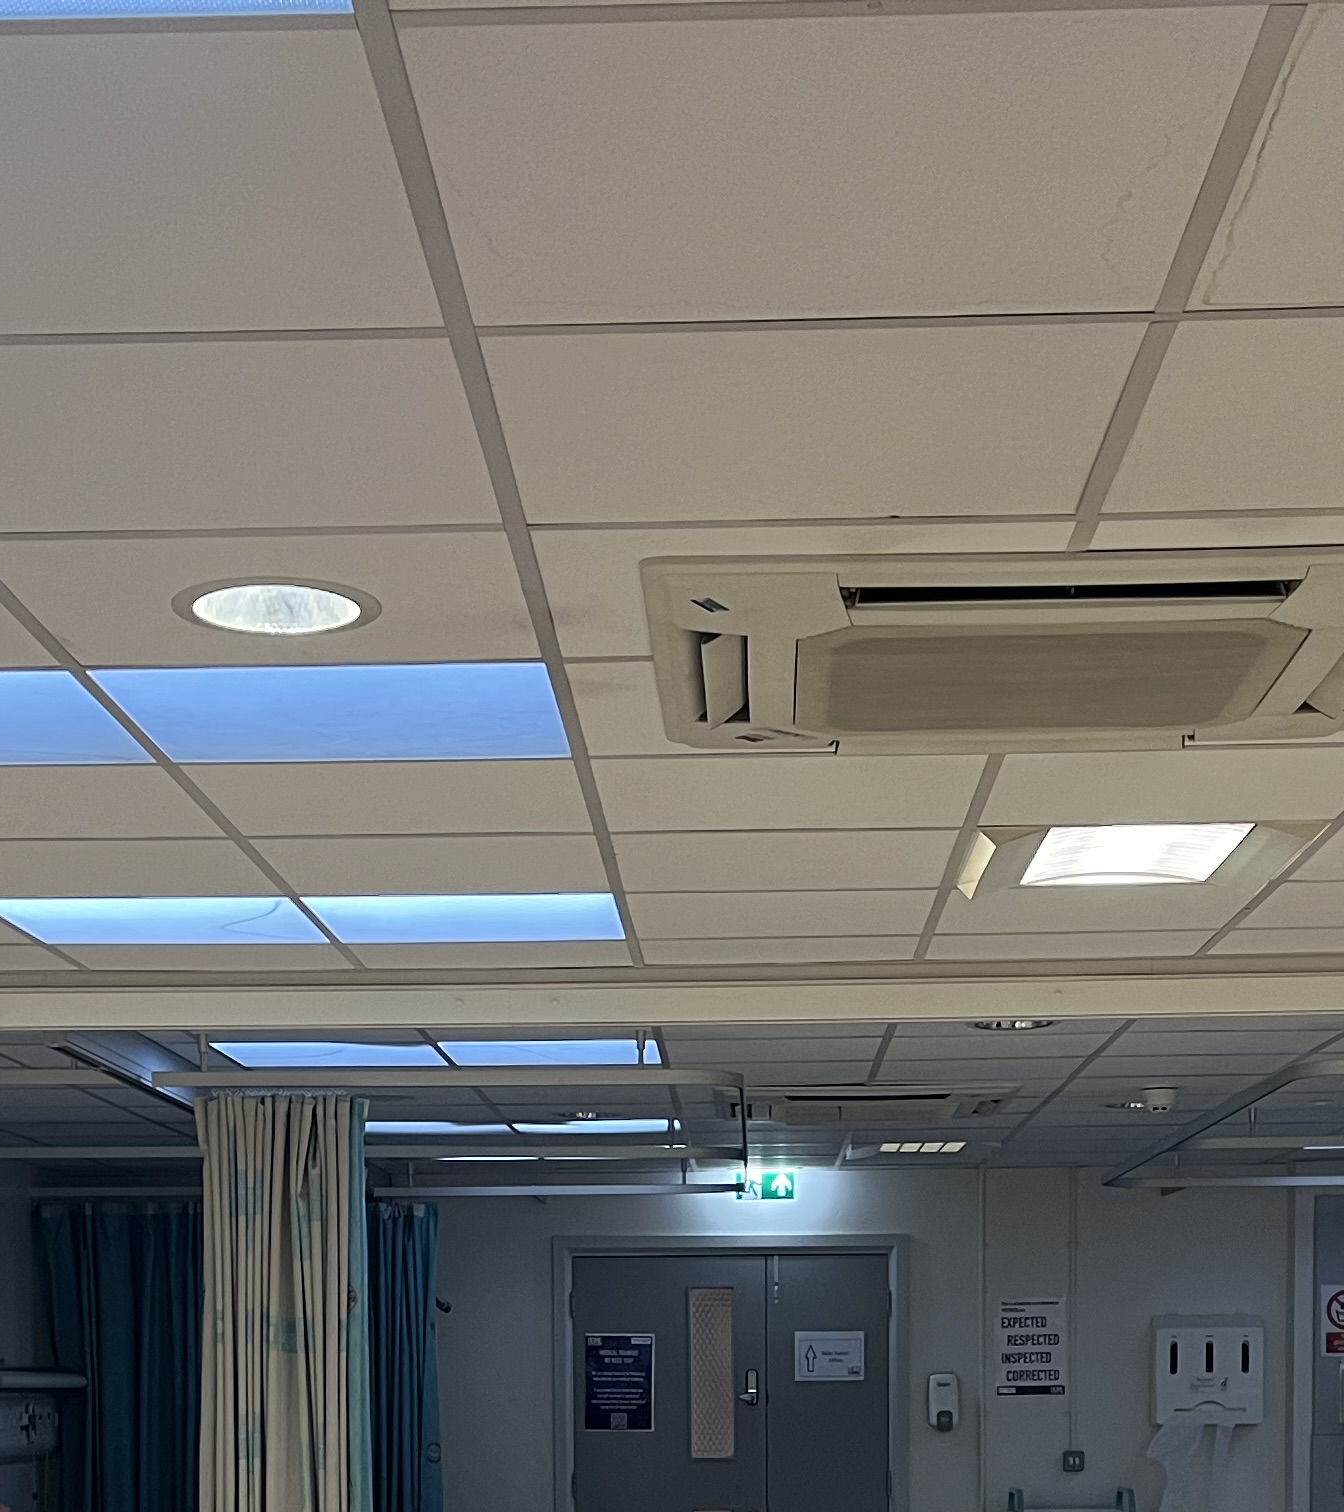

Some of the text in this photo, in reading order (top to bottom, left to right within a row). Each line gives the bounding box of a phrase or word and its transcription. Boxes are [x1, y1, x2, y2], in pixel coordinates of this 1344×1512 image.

[1001, 1316, 1047, 1328] EXPECTED
[1007, 1334, 1060, 1346] RESPECTED
[1001, 1352, 1052, 1364] INSPECTED
[1006, 1369, 1060, 1382] CORRECTED
